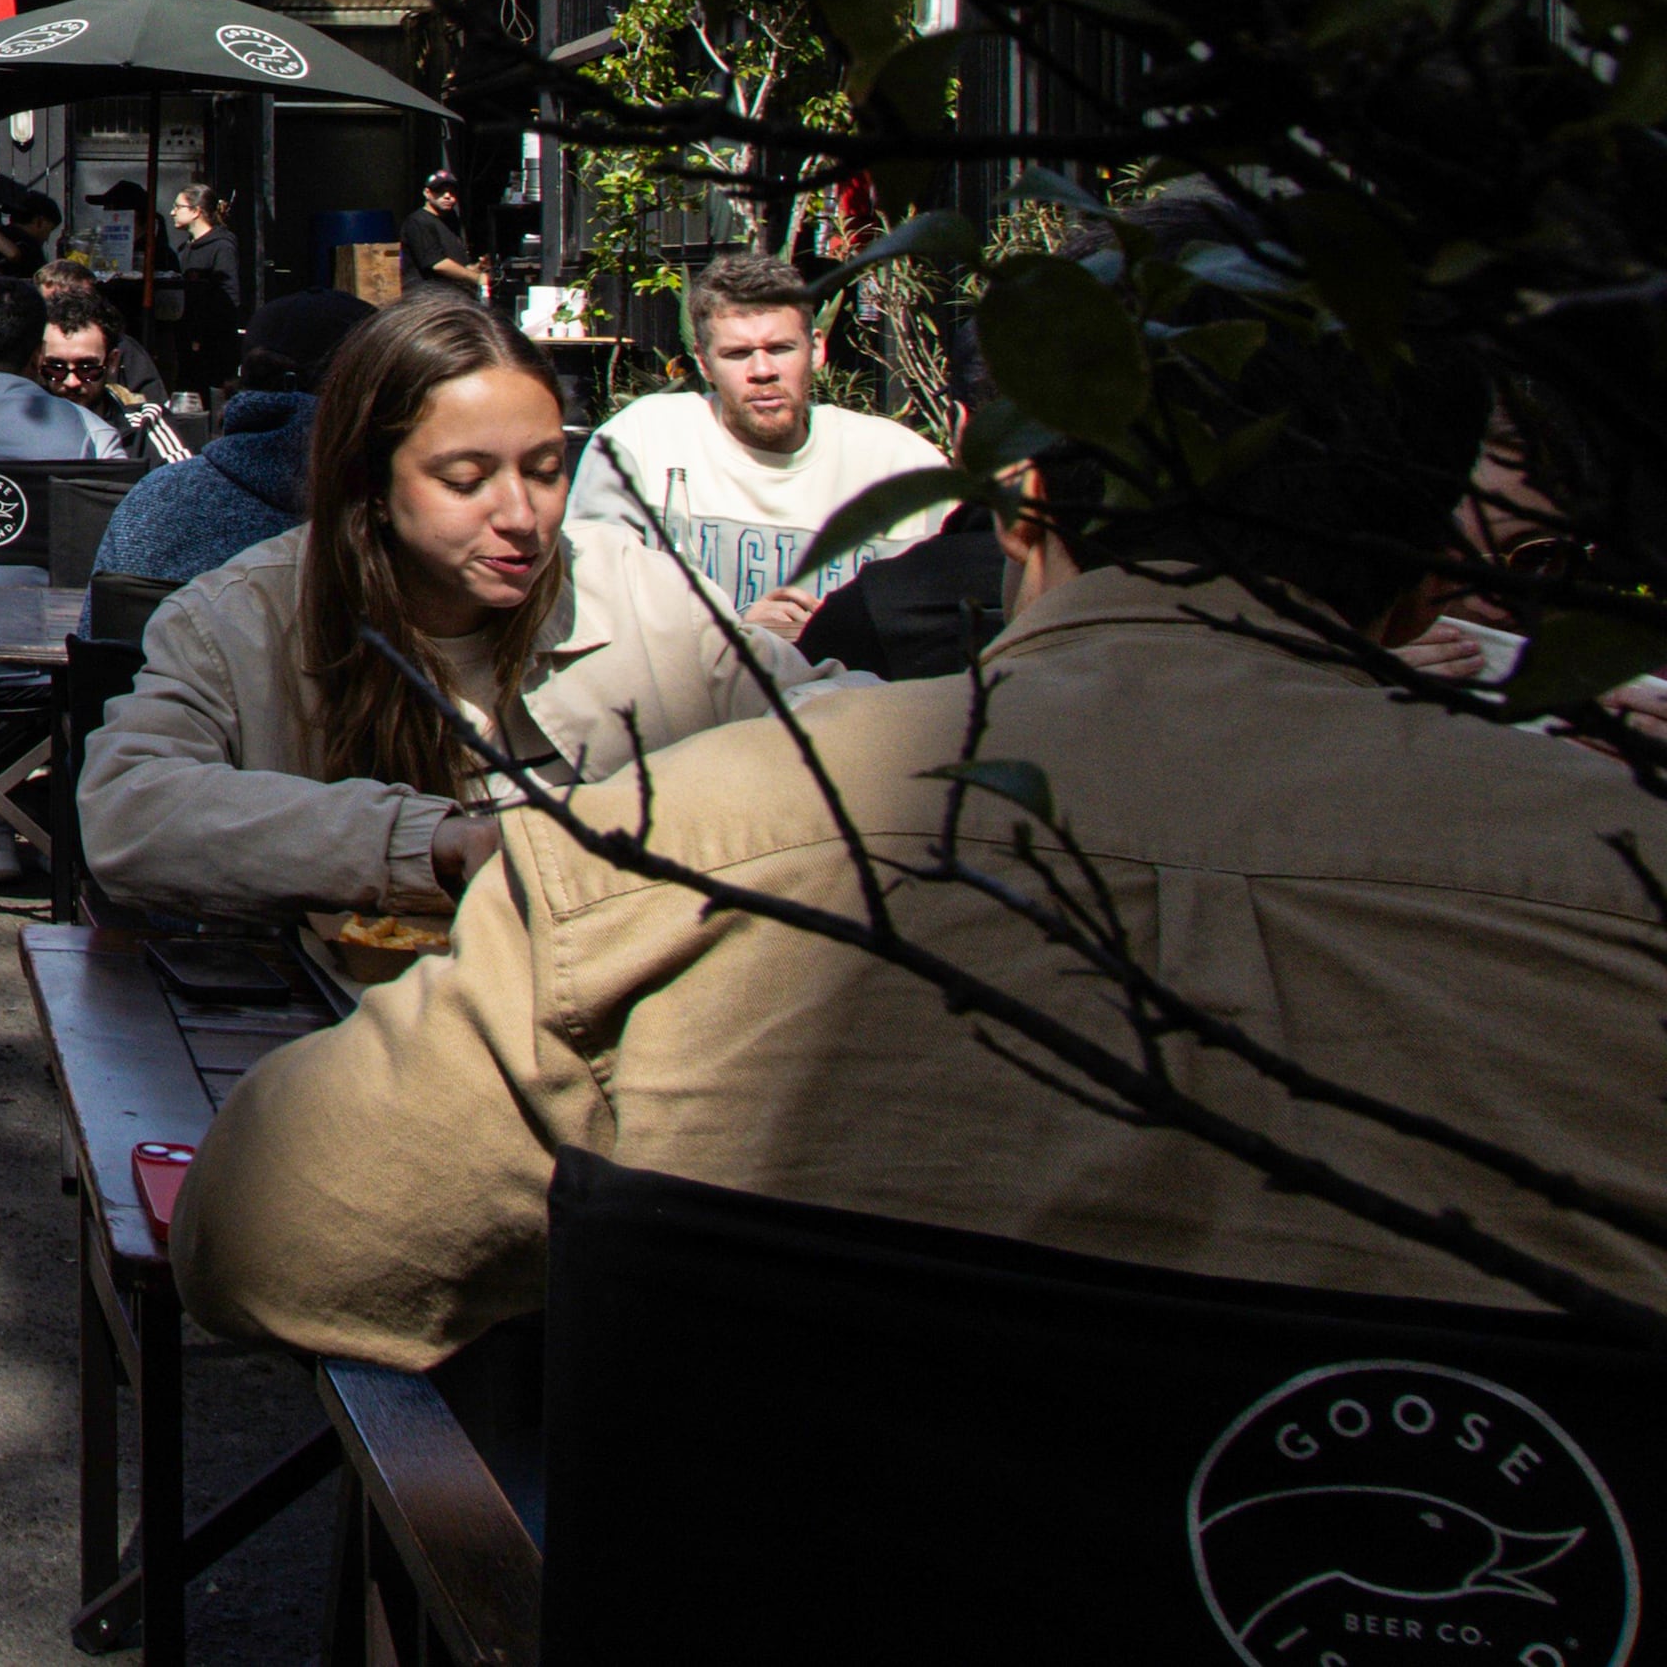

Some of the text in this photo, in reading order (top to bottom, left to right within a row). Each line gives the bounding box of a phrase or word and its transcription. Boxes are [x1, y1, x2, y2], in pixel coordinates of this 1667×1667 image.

[1275, 1393, 1545, 1486] GOOSE
[1343, 1612, 1424, 1639] BEER
[1435, 1622, 1493, 1647] CO.
